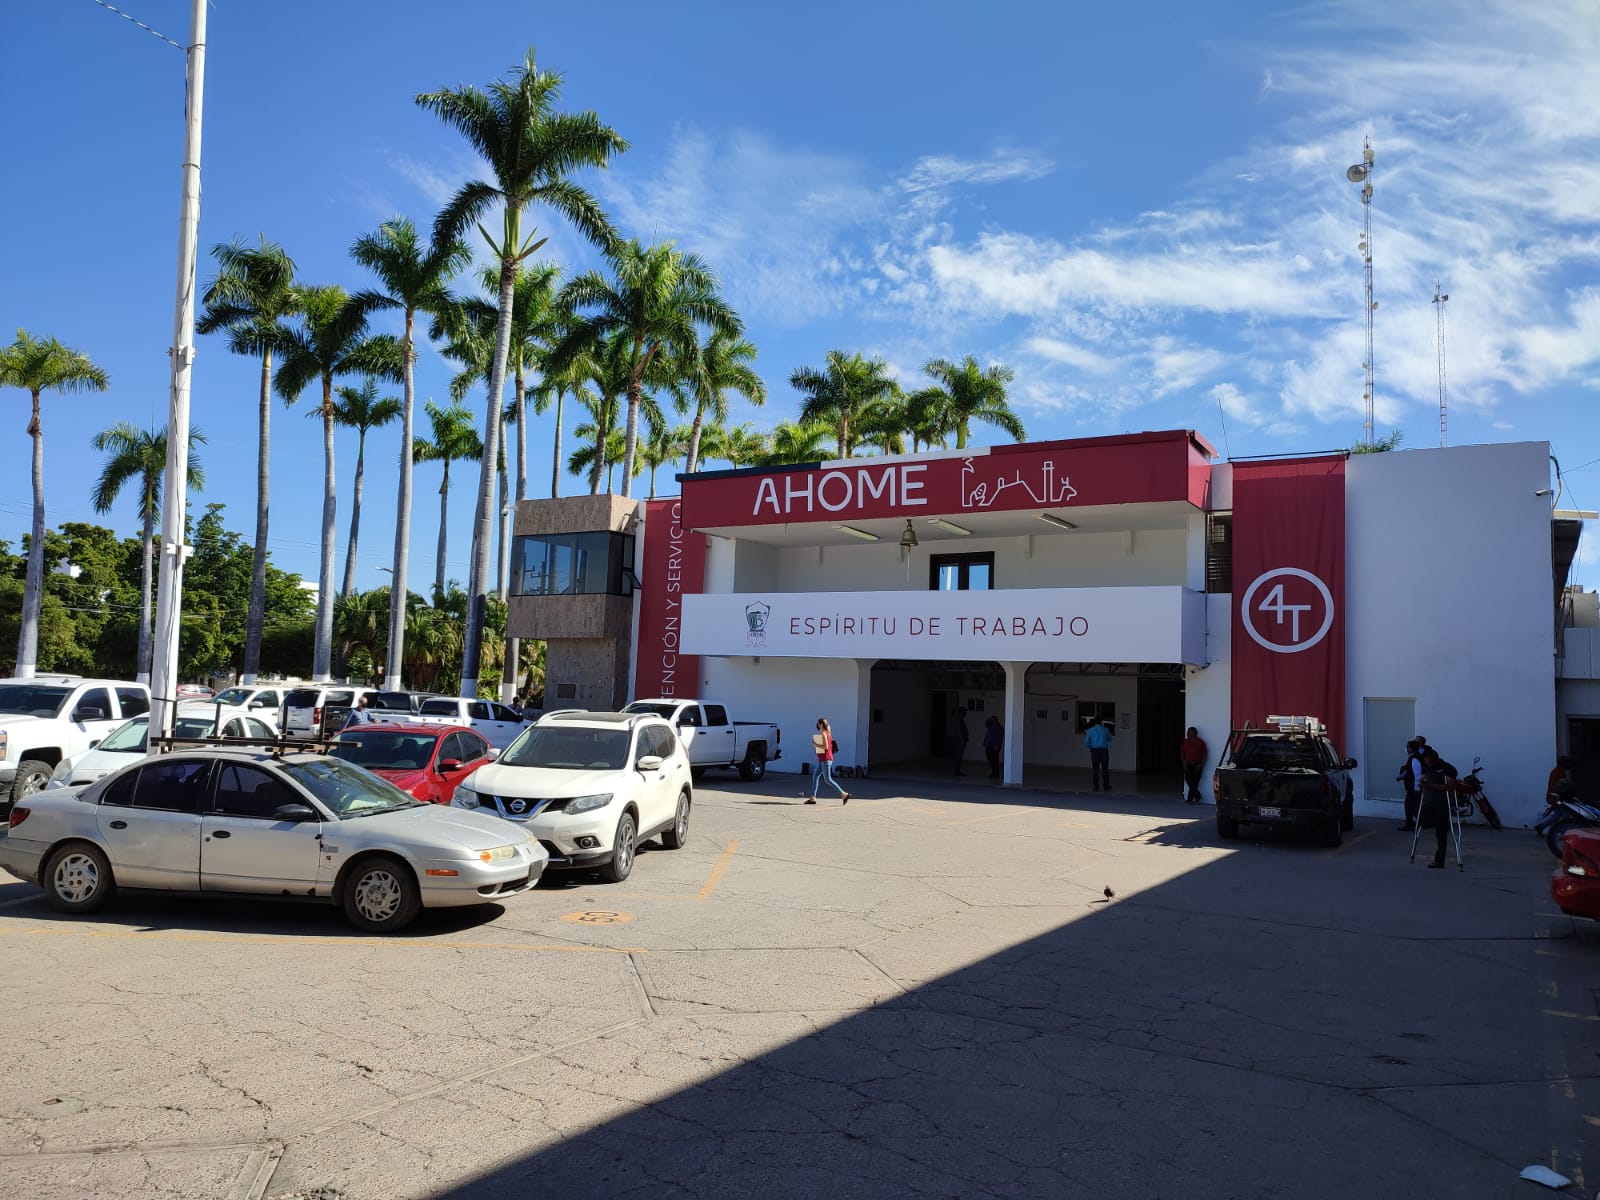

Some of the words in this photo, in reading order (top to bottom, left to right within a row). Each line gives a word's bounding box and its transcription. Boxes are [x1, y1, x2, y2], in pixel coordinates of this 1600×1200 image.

[753, 464, 928, 516] AHOME
[667, 503, 683, 593] SERVICIO
[666, 598, 680, 610] Y
[789, 613, 897, 636] ESPÍRITU
[909, 617, 941, 636] DE
[956, 616, 1089, 637] TRABAJO
[1258, 584, 1312, 642] 4T
[661, 617, 678, 699] ENCIÓN
